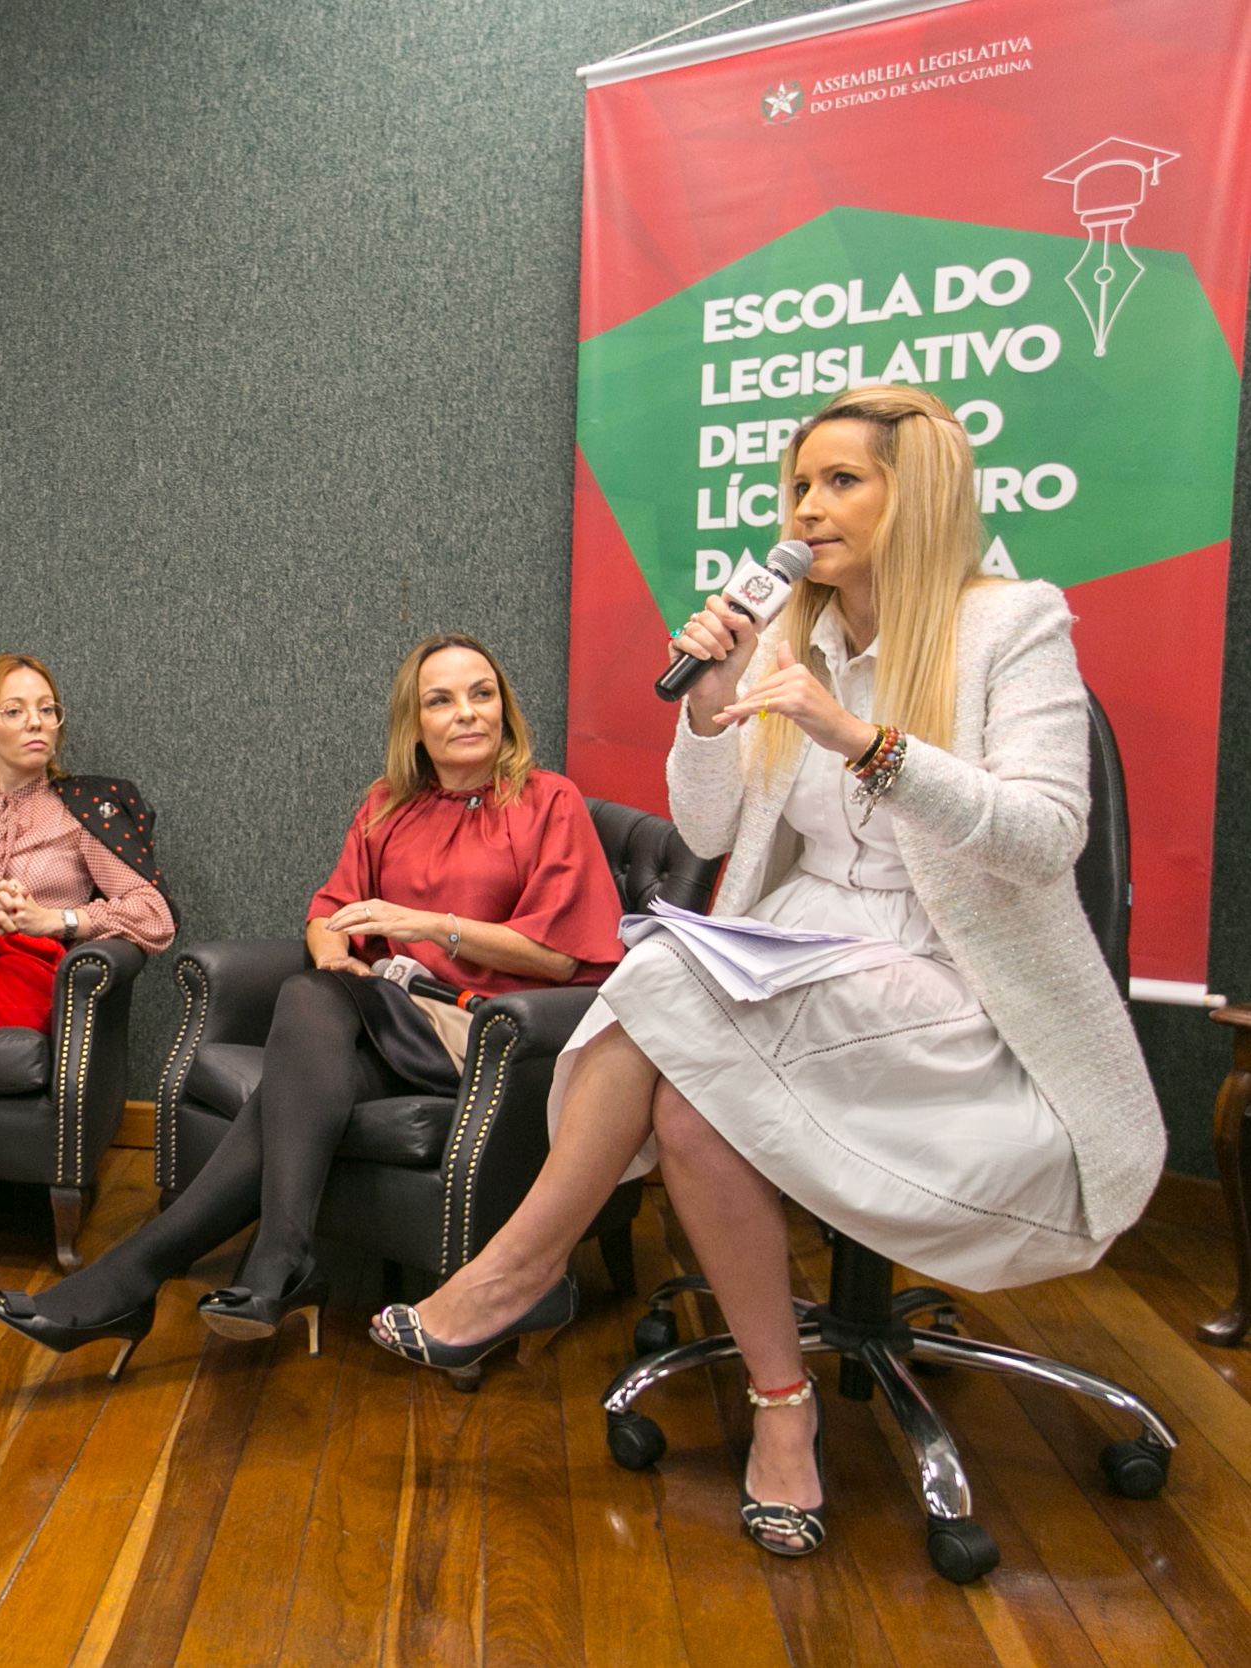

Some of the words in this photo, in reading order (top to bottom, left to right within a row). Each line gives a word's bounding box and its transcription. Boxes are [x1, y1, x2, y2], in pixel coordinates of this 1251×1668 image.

[810, 99, 833, 115] DO
[835, 88, 887, 109] ESTADO
[889, 83, 908, 98] DE
[910, 74, 957, 94] SANTA
[957, 58, 1032, 84] CATARINA
[811, 60, 914, 96] ASSEMBLEIA
[918, 36, 1033, 74] LEGISLATIVA
[702, 271, 924, 344] ESCOLA
[933, 257, 1032, 315] DO
[700, 323, 1062, 407] LEGISLATIVO
[696, 471, 787, 531] LÍCI
